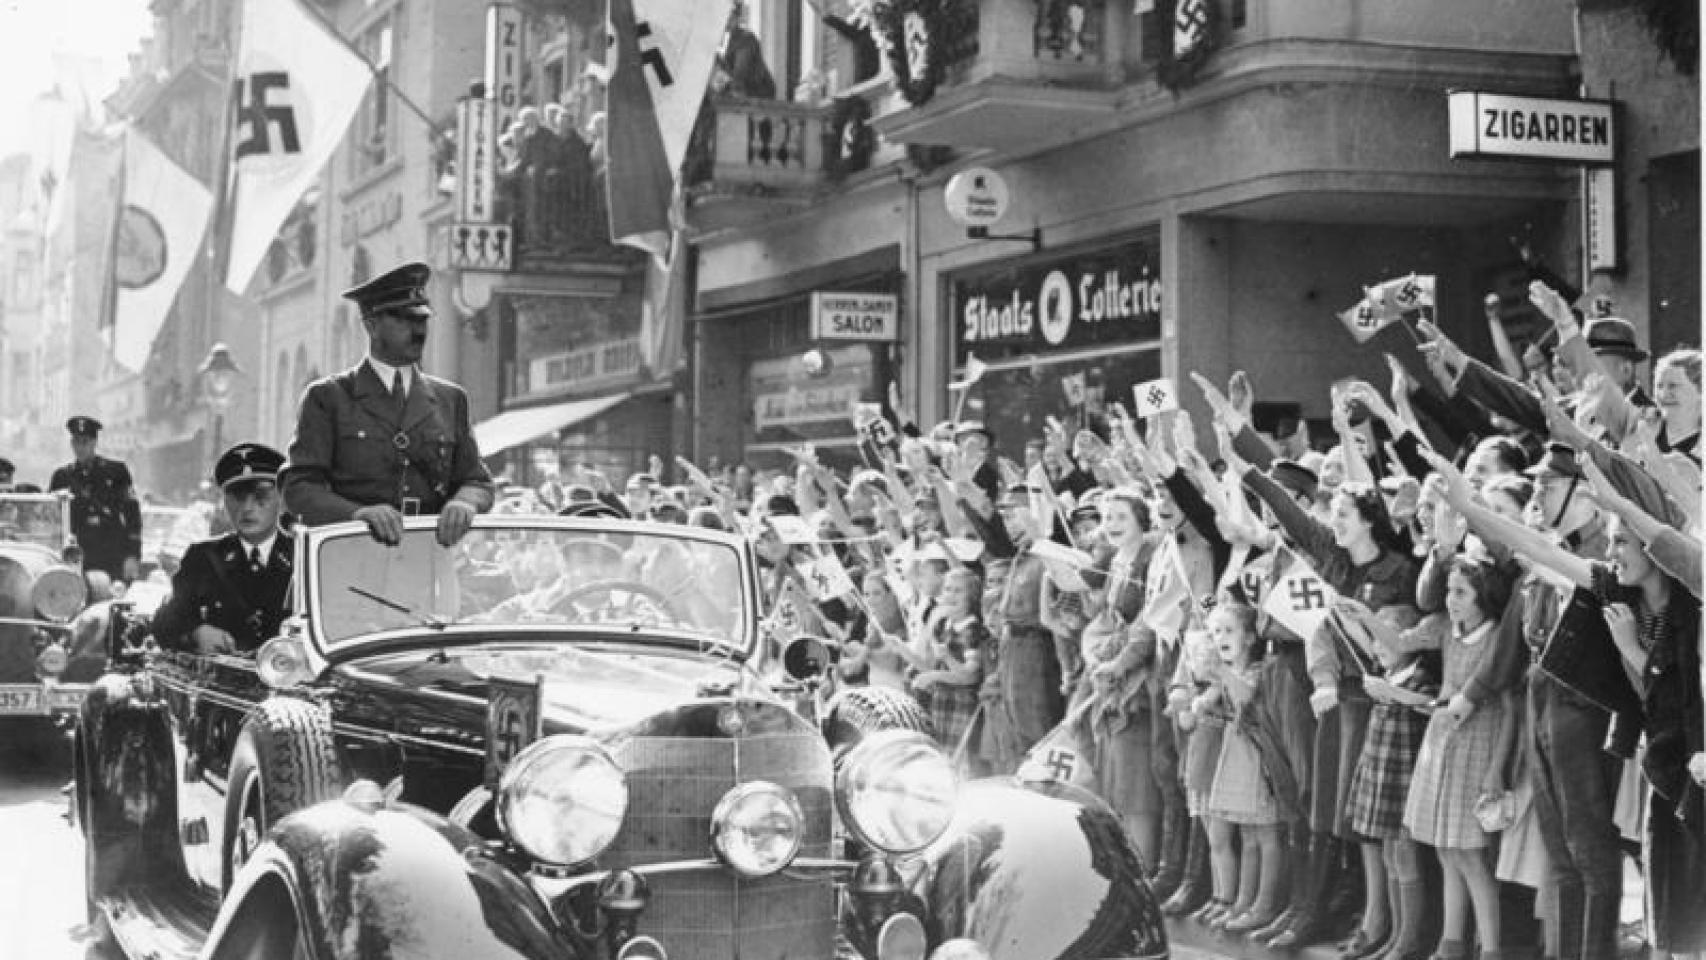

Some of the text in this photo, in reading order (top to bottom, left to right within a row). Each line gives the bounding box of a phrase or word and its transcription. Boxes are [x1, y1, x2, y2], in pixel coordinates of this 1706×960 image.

[1484, 108, 1608, 145] ZIGARREN
[964, 265, 1160, 341] Staats Lotterie
[832, 315, 884, 334] SALON
